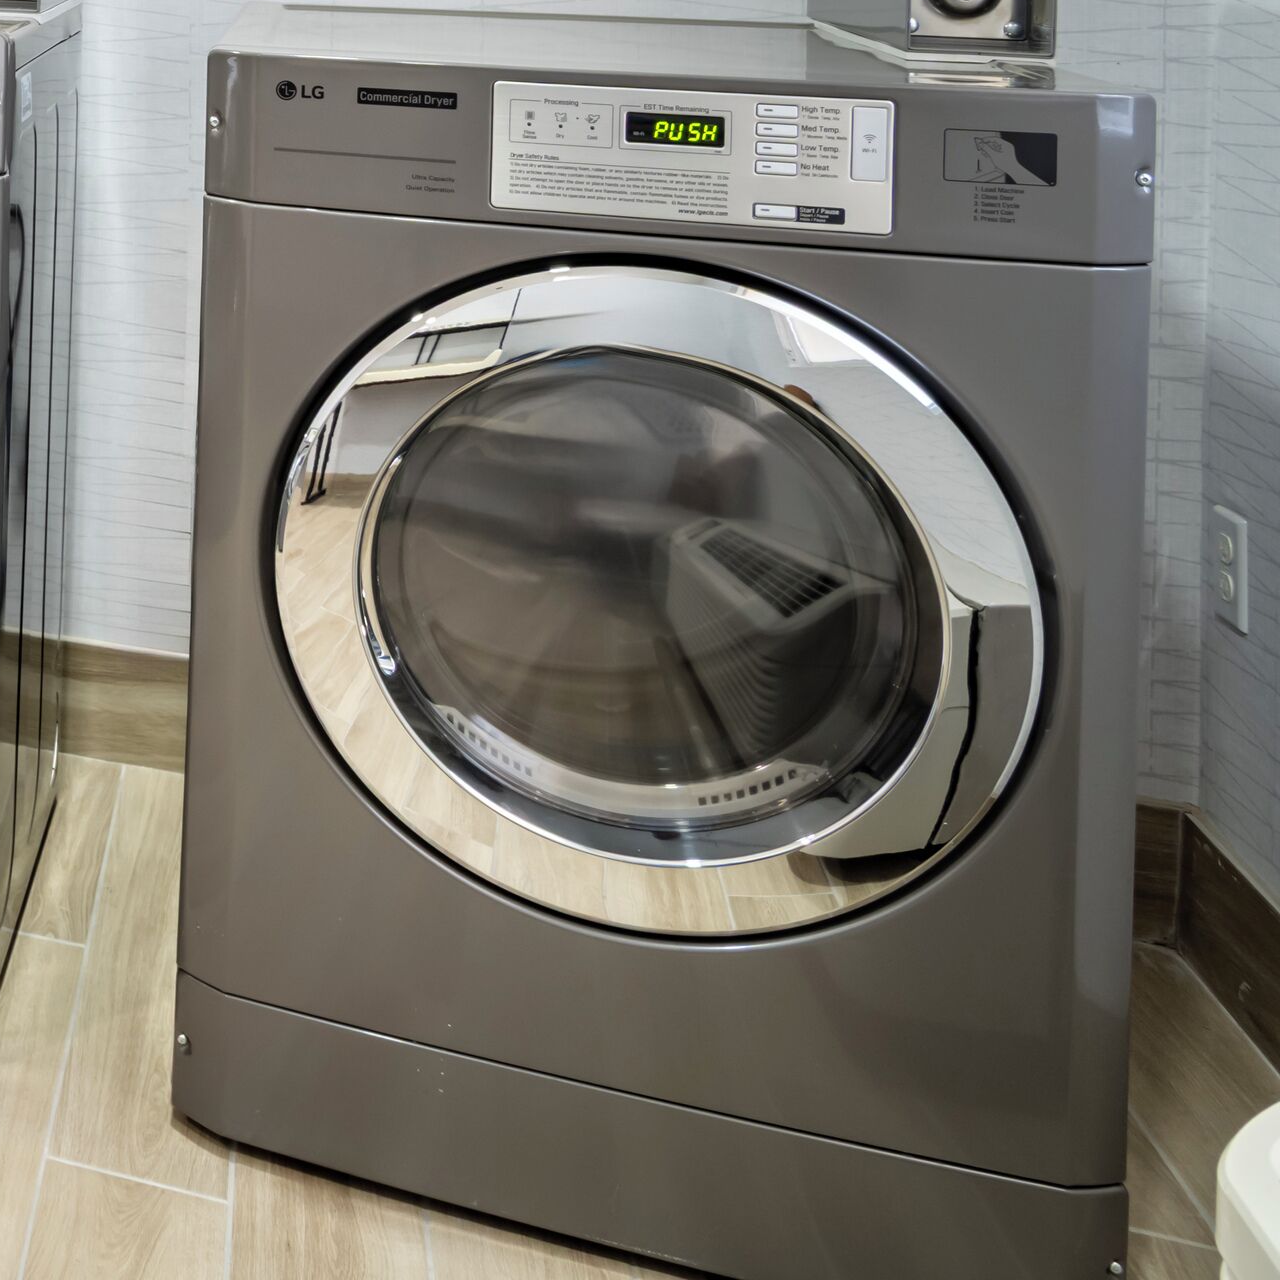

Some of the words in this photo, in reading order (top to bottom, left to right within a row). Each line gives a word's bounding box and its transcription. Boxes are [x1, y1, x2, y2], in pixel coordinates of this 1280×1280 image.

[301, 84, 325, 99] LG
[359, 90, 422, 105] Commercial
[424, 94, 455, 107] Dryer
[544, 98, 579, 107] Processing
[658, 104, 674, 112] Time
[675, 105, 710, 114] Remaining
[801, 106, 818, 114] High
[653, 120, 718, 142] PUSH
[800, 144, 817, 152] Low
[800, 163, 811, 171] No
[411, 173, 427, 181] Ultra
[428, 175, 455, 183] Capacity
[405, 184, 423, 192] Quiet
[424, 186, 455, 194] Operation
